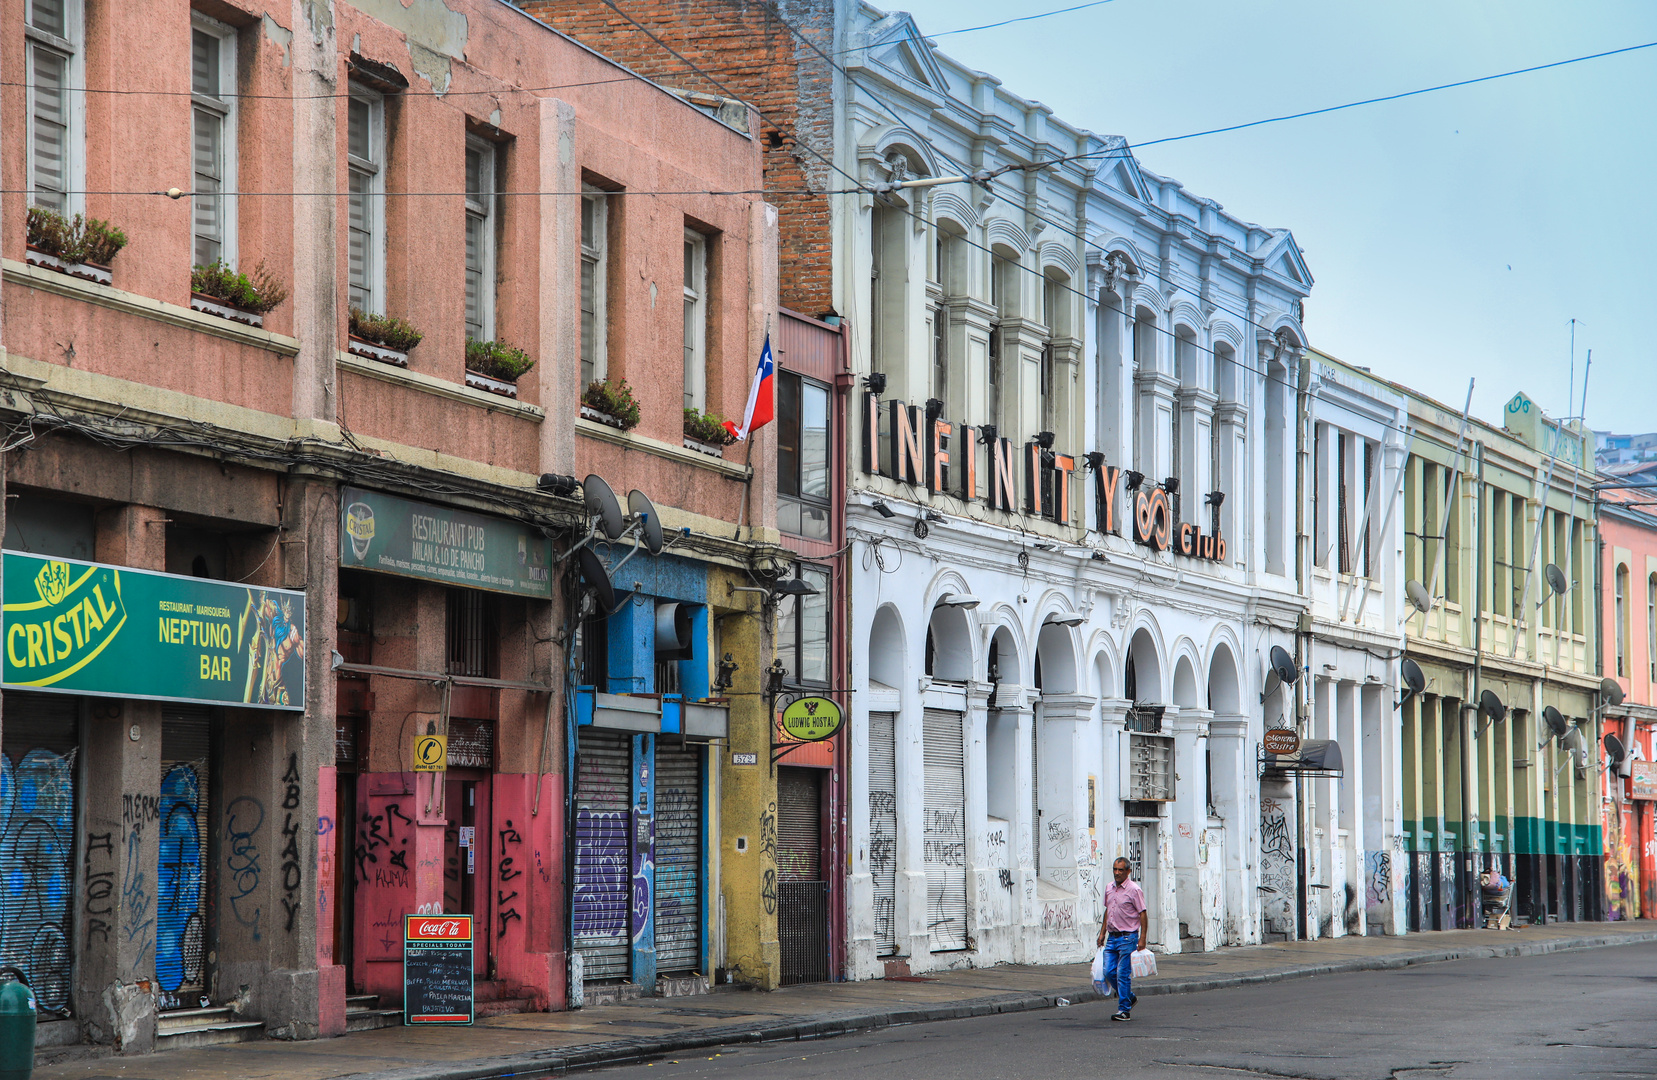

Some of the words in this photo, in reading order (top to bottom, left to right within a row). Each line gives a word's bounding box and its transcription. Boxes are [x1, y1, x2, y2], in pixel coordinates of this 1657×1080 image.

[863, 391, 1121, 535] INFINITY
[349, 518, 373, 536] CRISTAL
[412, 513, 466, 548] RESTAURANT
[467, 525, 485, 551] PUB
[1175, 522, 1226, 562] Club
[412, 541, 433, 563] MILAN
[435, 545, 440, 565] &
[441, 547, 449, 566] LO
[451, 548, 459, 568] DE
[461, 550, 485, 572] PANCHO
[159, 600, 194, 614] RESTAURANT
[7, 583, 117, 668] CRISTAL
[159, 616, 232, 650] NEPTUNO
[200, 654, 232, 682] BAR
[788, 716, 811, 728] LUDWIG
[812, 716, 835, 728] HOSTAL
[736, 754, 753, 764] 572
[1266, 742, 1294, 750] Bistro
[419, 920, 461, 936] Coca-Cola
